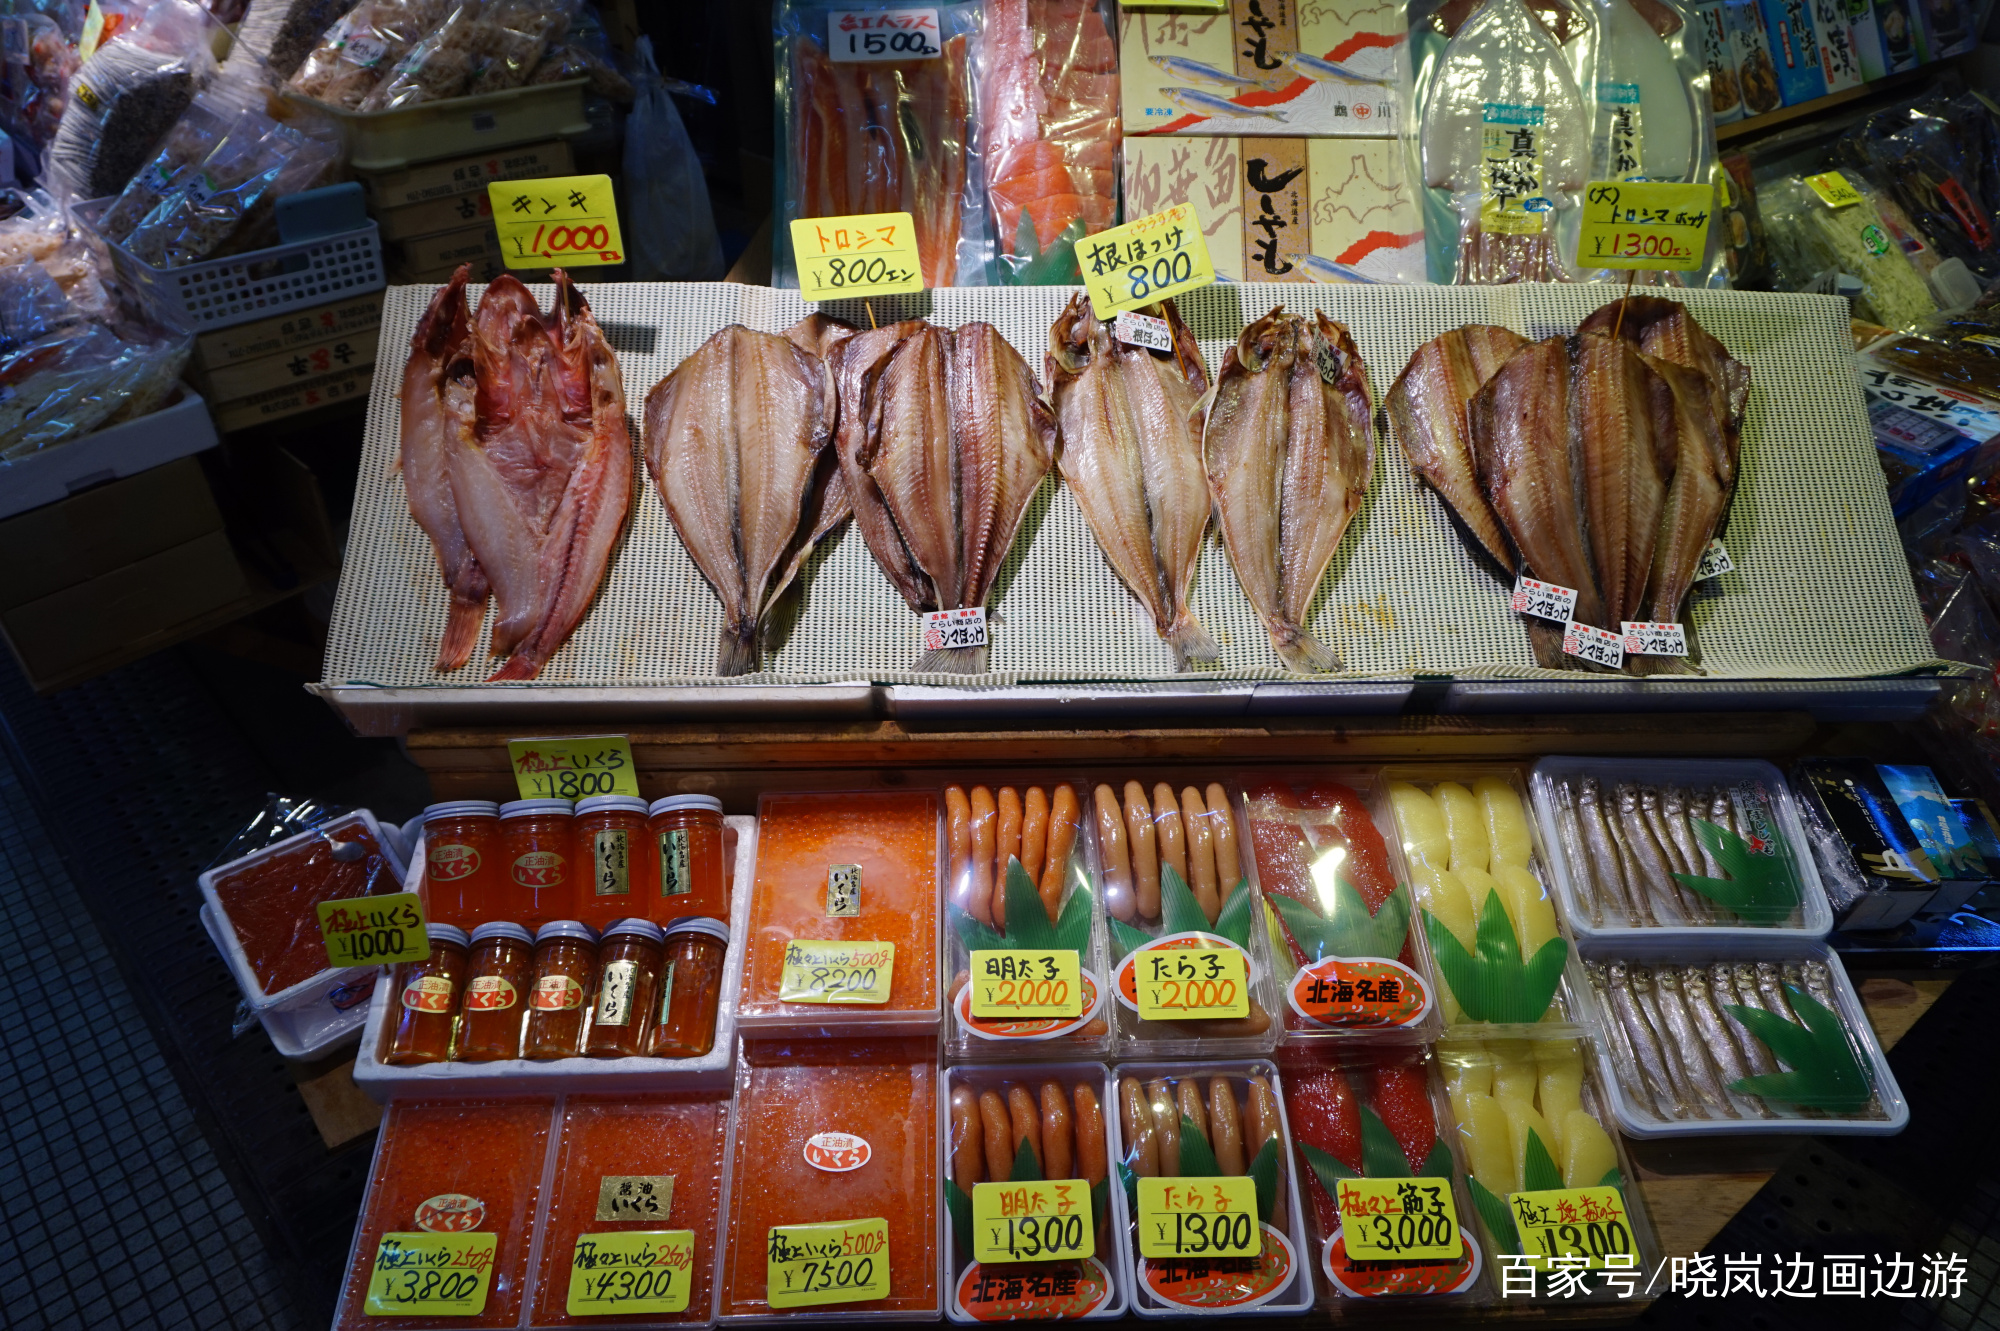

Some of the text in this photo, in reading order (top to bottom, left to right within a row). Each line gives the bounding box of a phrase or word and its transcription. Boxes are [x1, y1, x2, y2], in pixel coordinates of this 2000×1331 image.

[1145, 107, 1173, 116] 要冷凍
[511, 189, 588, 215] キンキ
[1290, 190, 1299, 225] 北海道産
[815, 225, 896, 253] トロシマ
[1086, 226, 1183, 276] 根ほっけ
[1132, 328, 1170, 348] 根ほっけ
[1570, 630, 1620, 649] てらい商店の
[1628, 629, 1680, 638] てらい商店の
[431, 857, 472, 877] いくら
[524, 855, 555, 867] 正油漬
[600, 841, 617, 890] いくら
[662, 842, 678, 890] いくら
[518, 865, 561, 884] いくら
[833, 872, 849, 912] いくら
[985, 956, 1060, 980] 明太子
[1151, 954, 1225, 980] たら子
[417, 980, 450, 992] 正油漬
[472, 979, 502, 990] 正油漬
[539, 979, 570, 990] 正油漬
[603, 971, 624, 1018] いくら
[1306, 979, 1400, 1003] 北海名産
[821, 1137, 854, 1148] 正油漬
[812, 1149, 861, 1167] いくら
[611, 1195, 659, 1213] いくら
[1000, 1185, 1077, 1217] 明太子
[1163, 1184, 1232, 1213] たら子
[425, 1211, 473, 1230] いくら
[969, 1270, 1077, 1303] 北海名産
